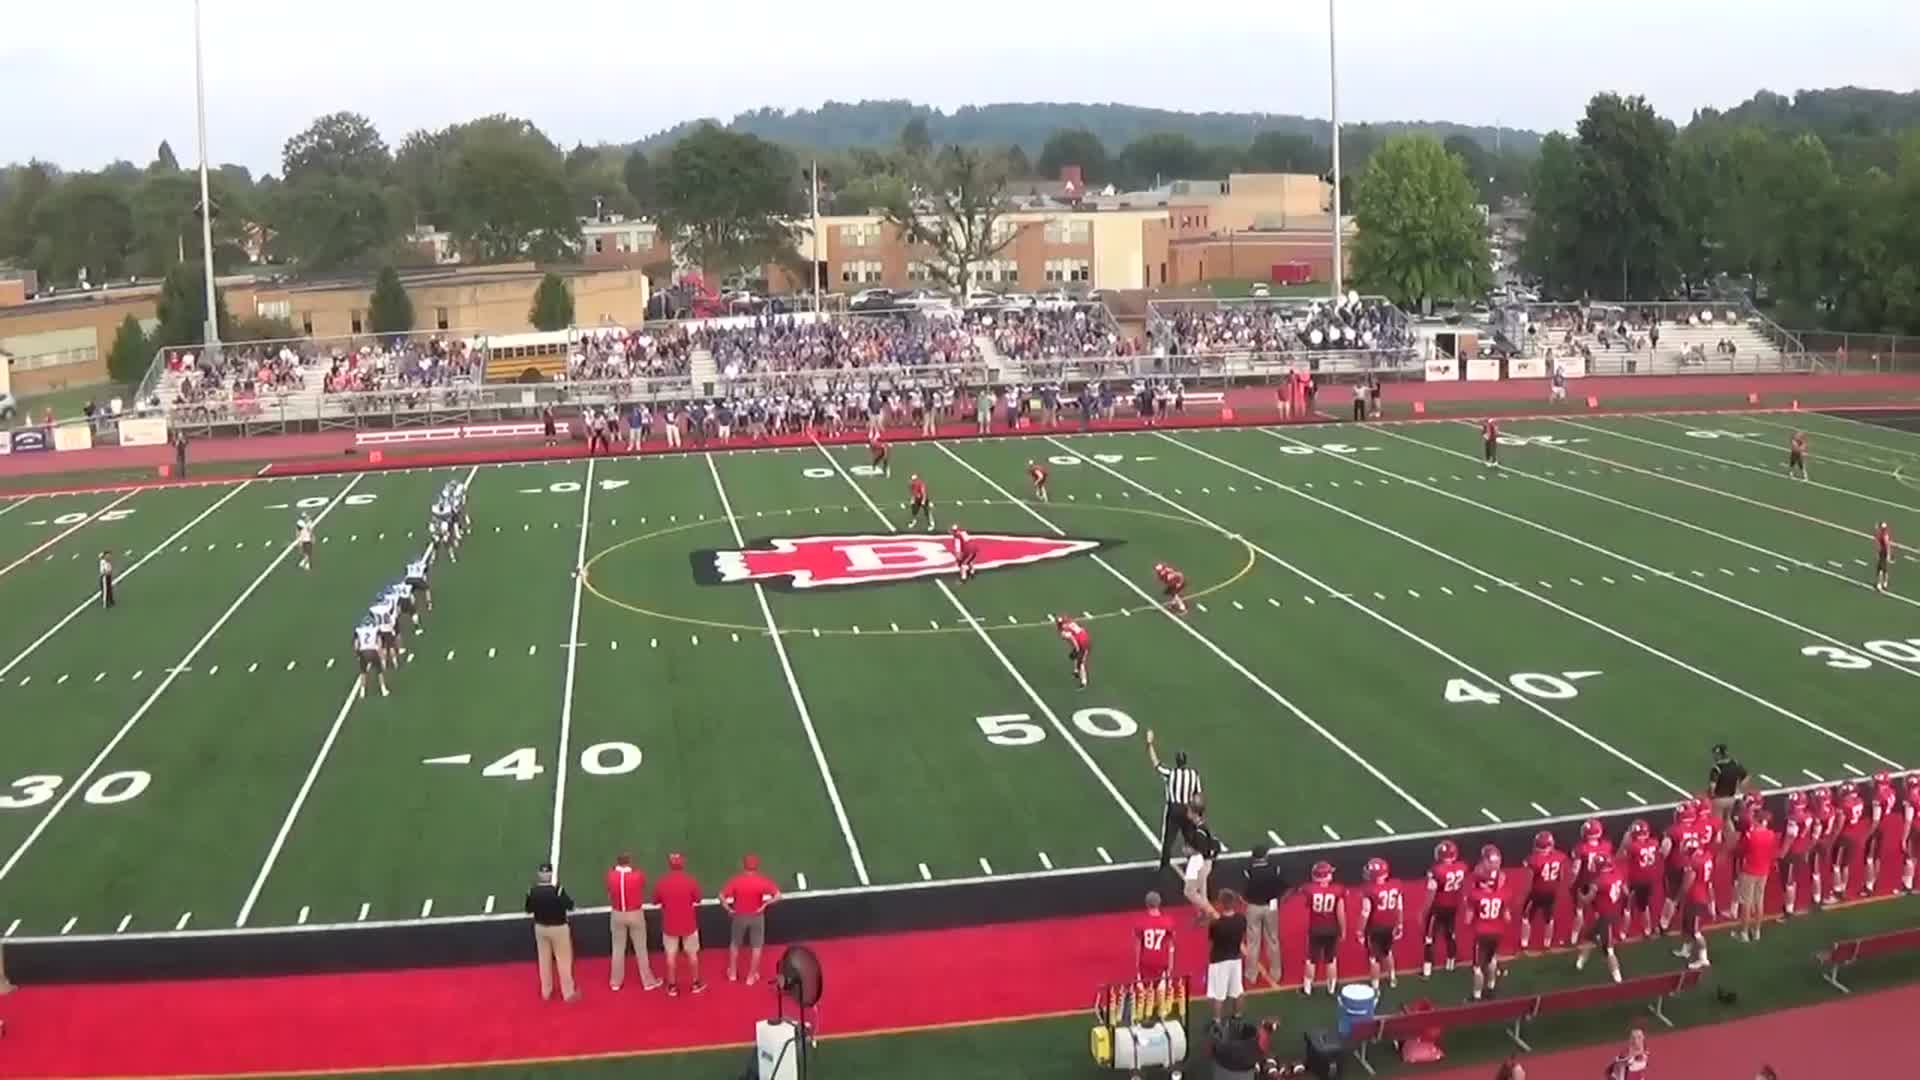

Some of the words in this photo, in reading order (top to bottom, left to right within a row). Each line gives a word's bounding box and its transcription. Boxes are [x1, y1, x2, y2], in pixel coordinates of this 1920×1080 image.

[1048, 453, 1124, 465] 40
[1280, 443, 1358, 455] 30
[803, 465, 885, 478] 50
[550, 479, 630, 493] 40
[296, 493, 378, 508] 30
[832, 541, 956, 571] B
[1801, 640, 1920, 669] 30
[1444, 672, 1578, 704] 40
[976, 707, 1139, 747] 50
[481, 741, 643, 783] 40
[0, 770, 152, 808] 30
[1443, 871, 1465, 892] 22
[1541, 860, 1561, 881] 42
[1312, 893, 1335, 913] 80
[1377, 889, 1398, 911] 36
[1479, 898, 1500, 920] 38
[1143, 929, 1166, 951] 87
